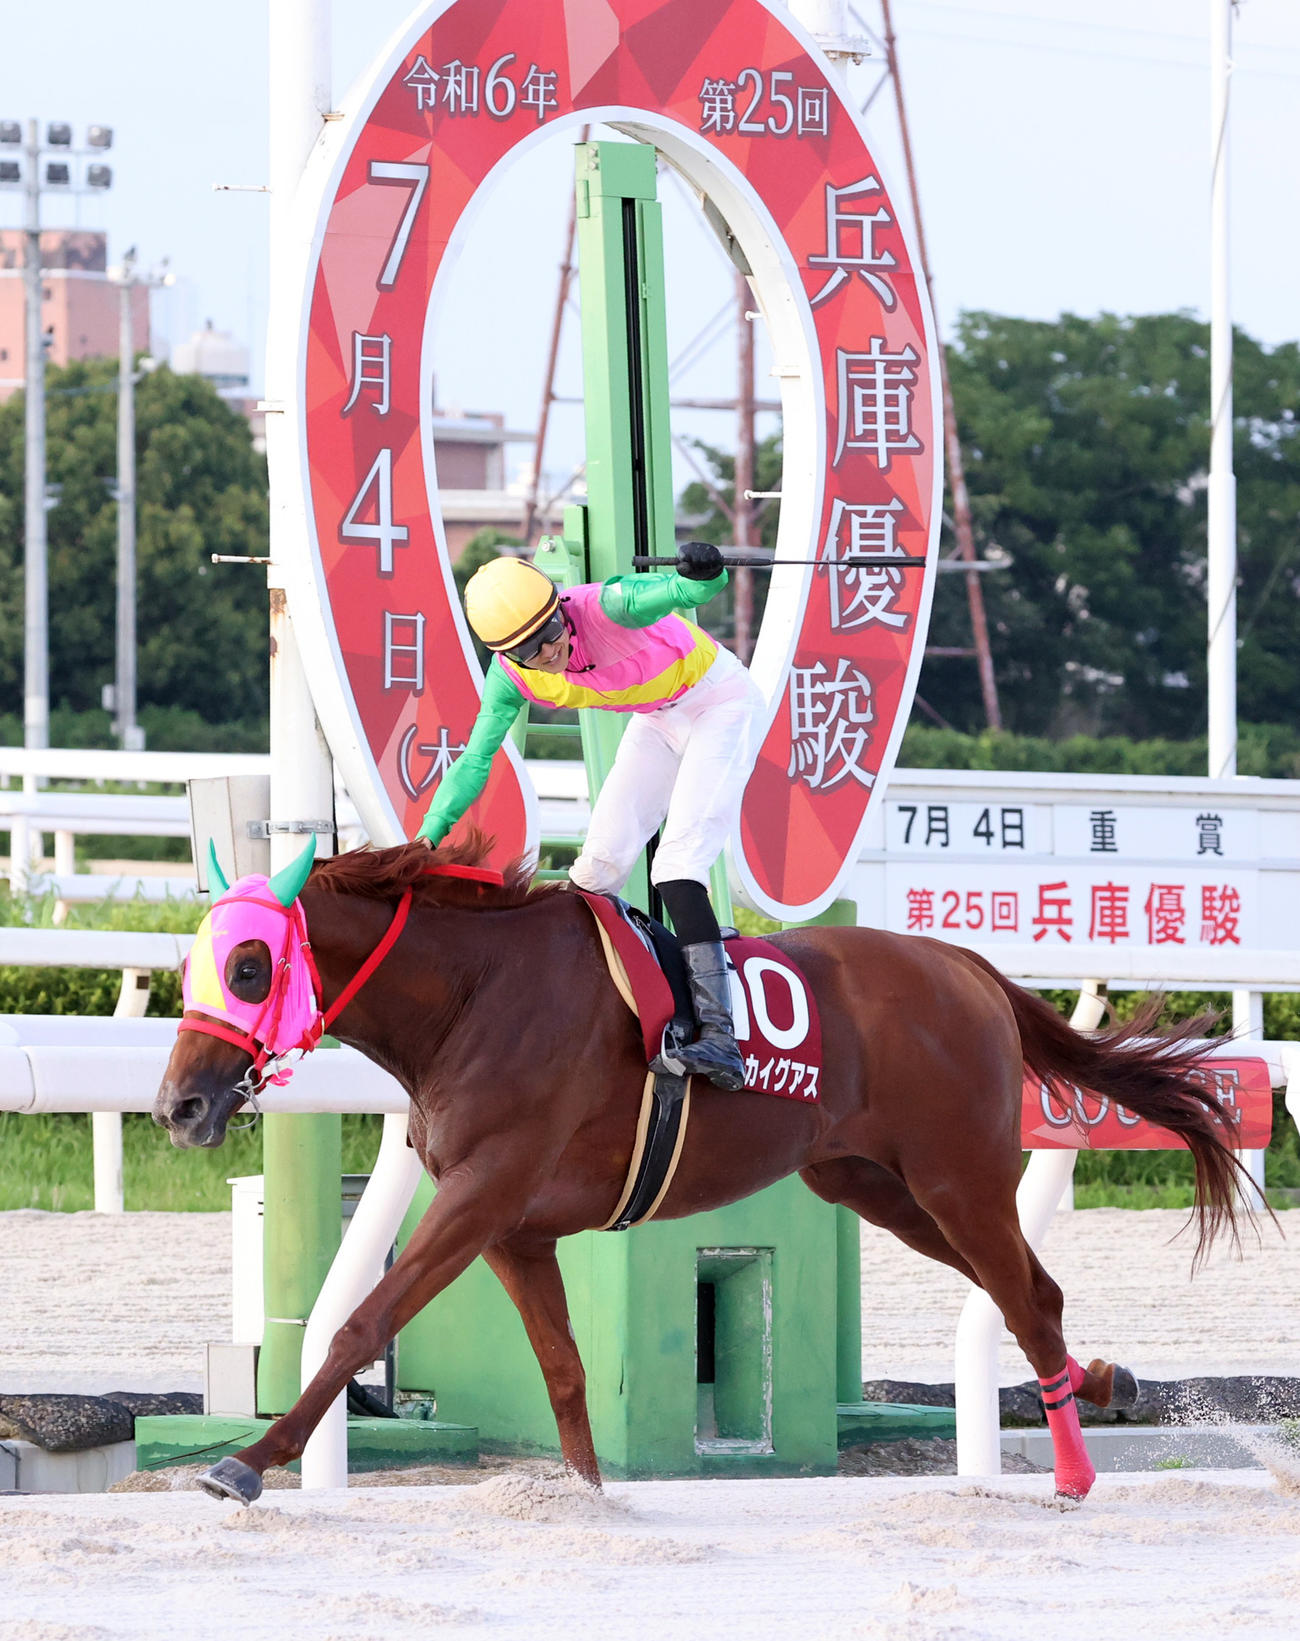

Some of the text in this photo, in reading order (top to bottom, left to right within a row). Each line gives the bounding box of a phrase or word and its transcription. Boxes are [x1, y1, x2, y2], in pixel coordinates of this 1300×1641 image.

[404, 54, 557, 117] 令和6年
[700, 69, 829, 136] 第25回
[787, 176, 926, 790] 兵庫優駿
[898, 805, 1025, 849] 7月4日
[1090, 810, 1223, 856] 重賞
